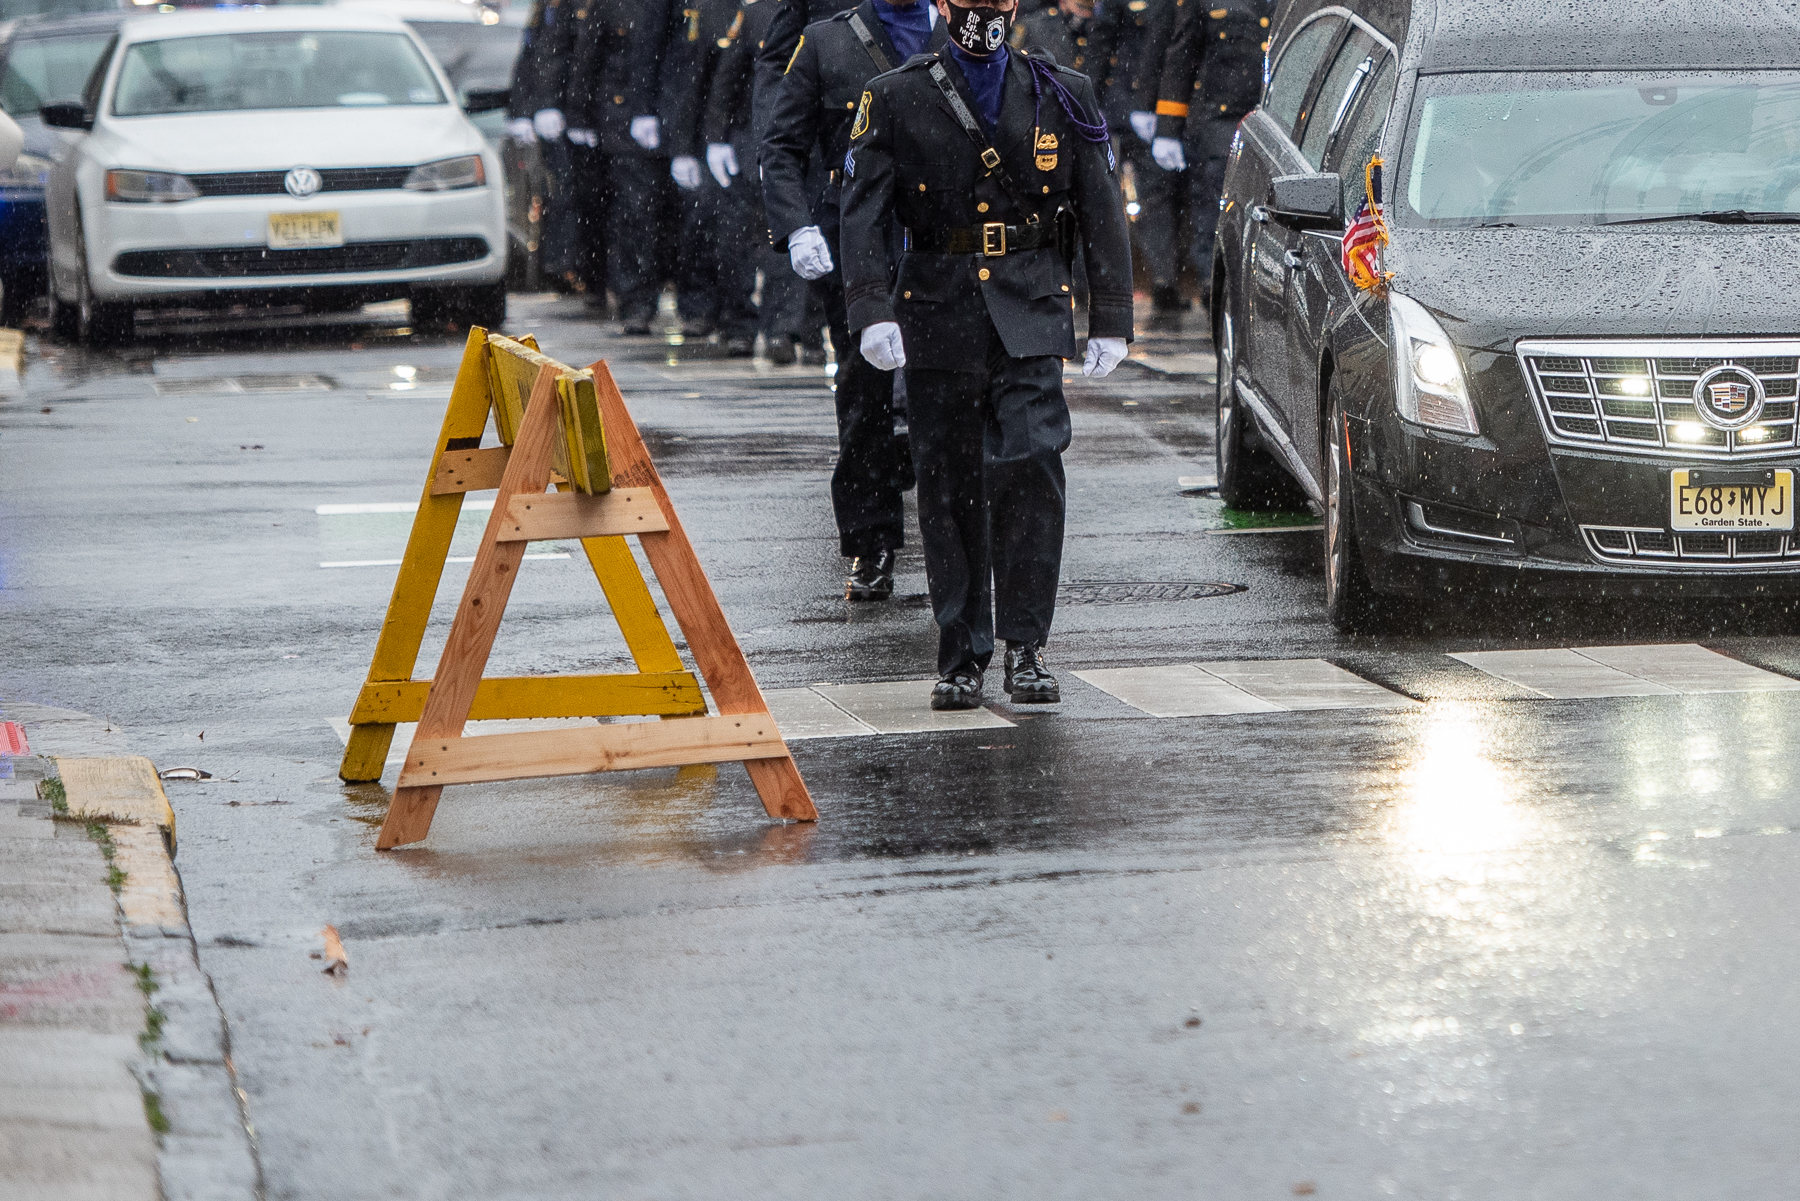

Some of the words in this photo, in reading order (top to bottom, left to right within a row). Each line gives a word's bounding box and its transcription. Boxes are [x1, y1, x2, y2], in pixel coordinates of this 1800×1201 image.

[967, 10, 980, 25] RIP
[965, 22, 978, 33] Sgt.
[961, 36, 974, 49] S-6
[1679, 485, 1723, 516] E68
[1740, 485, 1785, 516] MYJ
[1701, 518, 1735, 527] Garden
[1737, 518, 1763, 527] State
